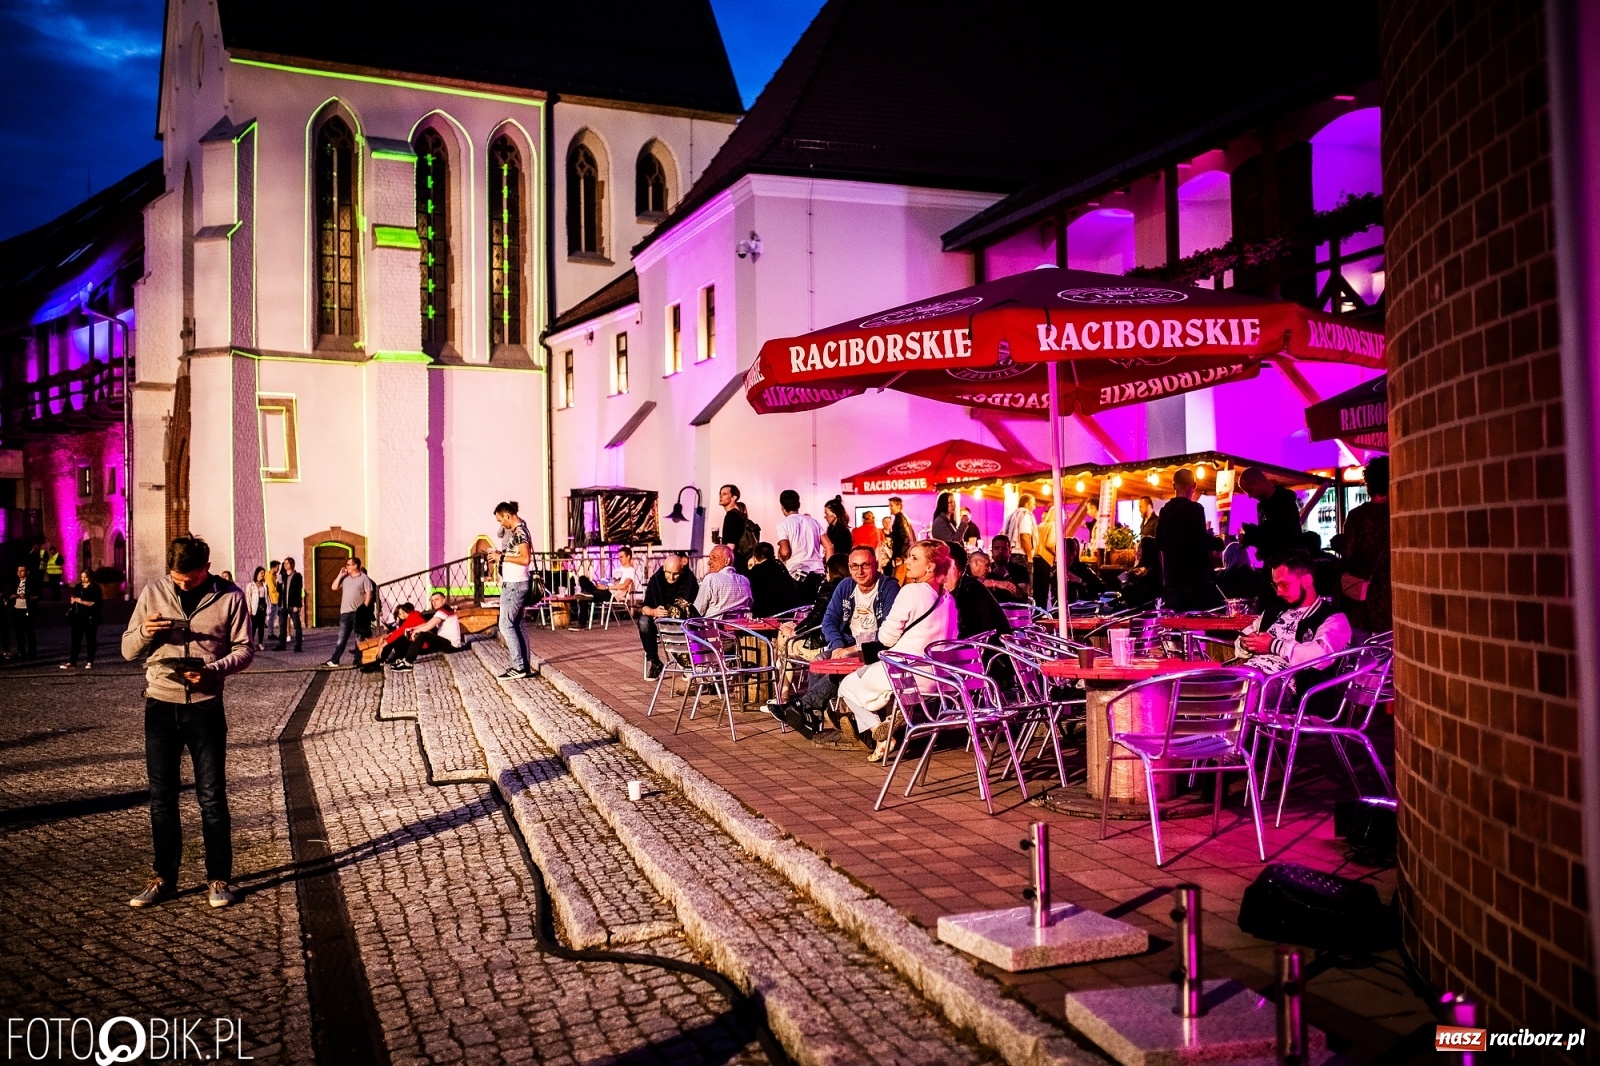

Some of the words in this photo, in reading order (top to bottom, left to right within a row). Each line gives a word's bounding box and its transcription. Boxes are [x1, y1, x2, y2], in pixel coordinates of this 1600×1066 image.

[789, 328, 972, 373] RACIBORSKIE
[1036, 318, 1261, 351] RACIBORSKIE
[1308, 319, 1385, 359] RACIBORSKIE
[863, 477, 927, 492] RACIBORSKIE
